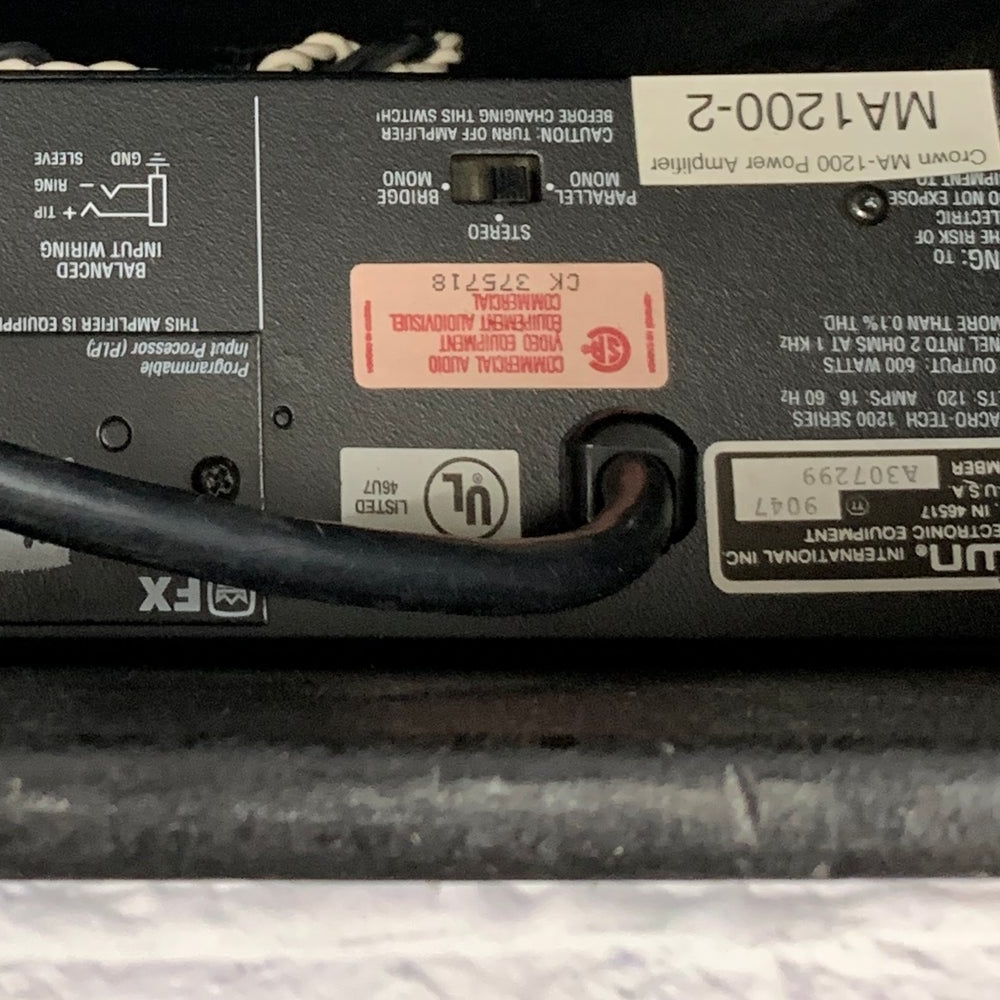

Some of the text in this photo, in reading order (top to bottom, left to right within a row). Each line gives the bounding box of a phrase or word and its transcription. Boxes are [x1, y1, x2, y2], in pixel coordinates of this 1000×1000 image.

[375, 107, 613, 124] BEFORE CHANGING THIS SWITCH!
[685, 90, 938, 133] MA1200-2
[381, 125, 613, 143] CAUTION: TURN OFF AMPLIFIER
[33, 150, 84, 165] SLEEVE
[110, 150, 142, 165] GND
[649, 148, 987, 175] Crown MA-1200 Power Amplifier
[33, 177, 68, 193] RING
[382, 169, 432, 186] MONO
[569, 170, 620, 187] MONO
[376, 188, 439, 205] BRIDGE
[554, 188, 637, 206] PARALLEL
[887, 190, 949, 206] EXPOSE
[952, 190, 984, 206] NOT
[34, 204, 56, 220] TIP
[467, 223, 532, 240] STEREO
[914, 229, 935, 245] OF
[938, 229, 975, 245] RISK
[39, 240, 162, 259] INPUT WIRING
[933, 248, 955, 265] TO
[55, 260, 147, 279] BALANCED
[430, 272, 580, 292] CK 375718
[471, 292, 562, 311] COMMERCIAL
[61, 316, 77, 332] IS
[81, 316, 161, 332] AMPLIFIER
[163, 316, 199, 332] THIS
[388, 313, 475, 332] AUDIOVISUEL
[862, 315, 903, 332] 0.1%
[907, 315, 952, 331] THAN
[131, 341, 206, 357] Processor
[210, 338, 249, 357] Input
[438, 333, 563, 352] VIDEO EQUIPMENT
[778, 334, 811, 352] KHz
[816, 336, 824, 352] 1
[830, 336, 851, 352] AT
[855, 335, 906, 352] OHMS
[910, 336, 920, 352] 2
[925, 336, 964, 352] INTO
[140, 358, 249, 377] Programmable
[427, 355, 564, 374] COMMERCIAL AUDIO
[822, 357, 997, 374] OUTPUT: 600 WATTS
[780, 389, 800, 407] Hz
[804, 389, 826, 407] 60
[839, 389, 858, 407] 16
[937, 390, 965, 407] 120
[791, 411, 851, 428] SERIES
[856, 411, 895, 428] 1200
[801, 464, 919, 487] A307299
[362, 479, 398, 495] 46U7
[354, 499, 408, 515] LISTED
[754, 496, 818, 517] 9047
[920, 503, 967, 519] 46517
[804, 525, 907, 543] EQUIPMENT
[763, 547, 904, 563] INTERNATIONAL
[138, 576, 201, 612] FX
